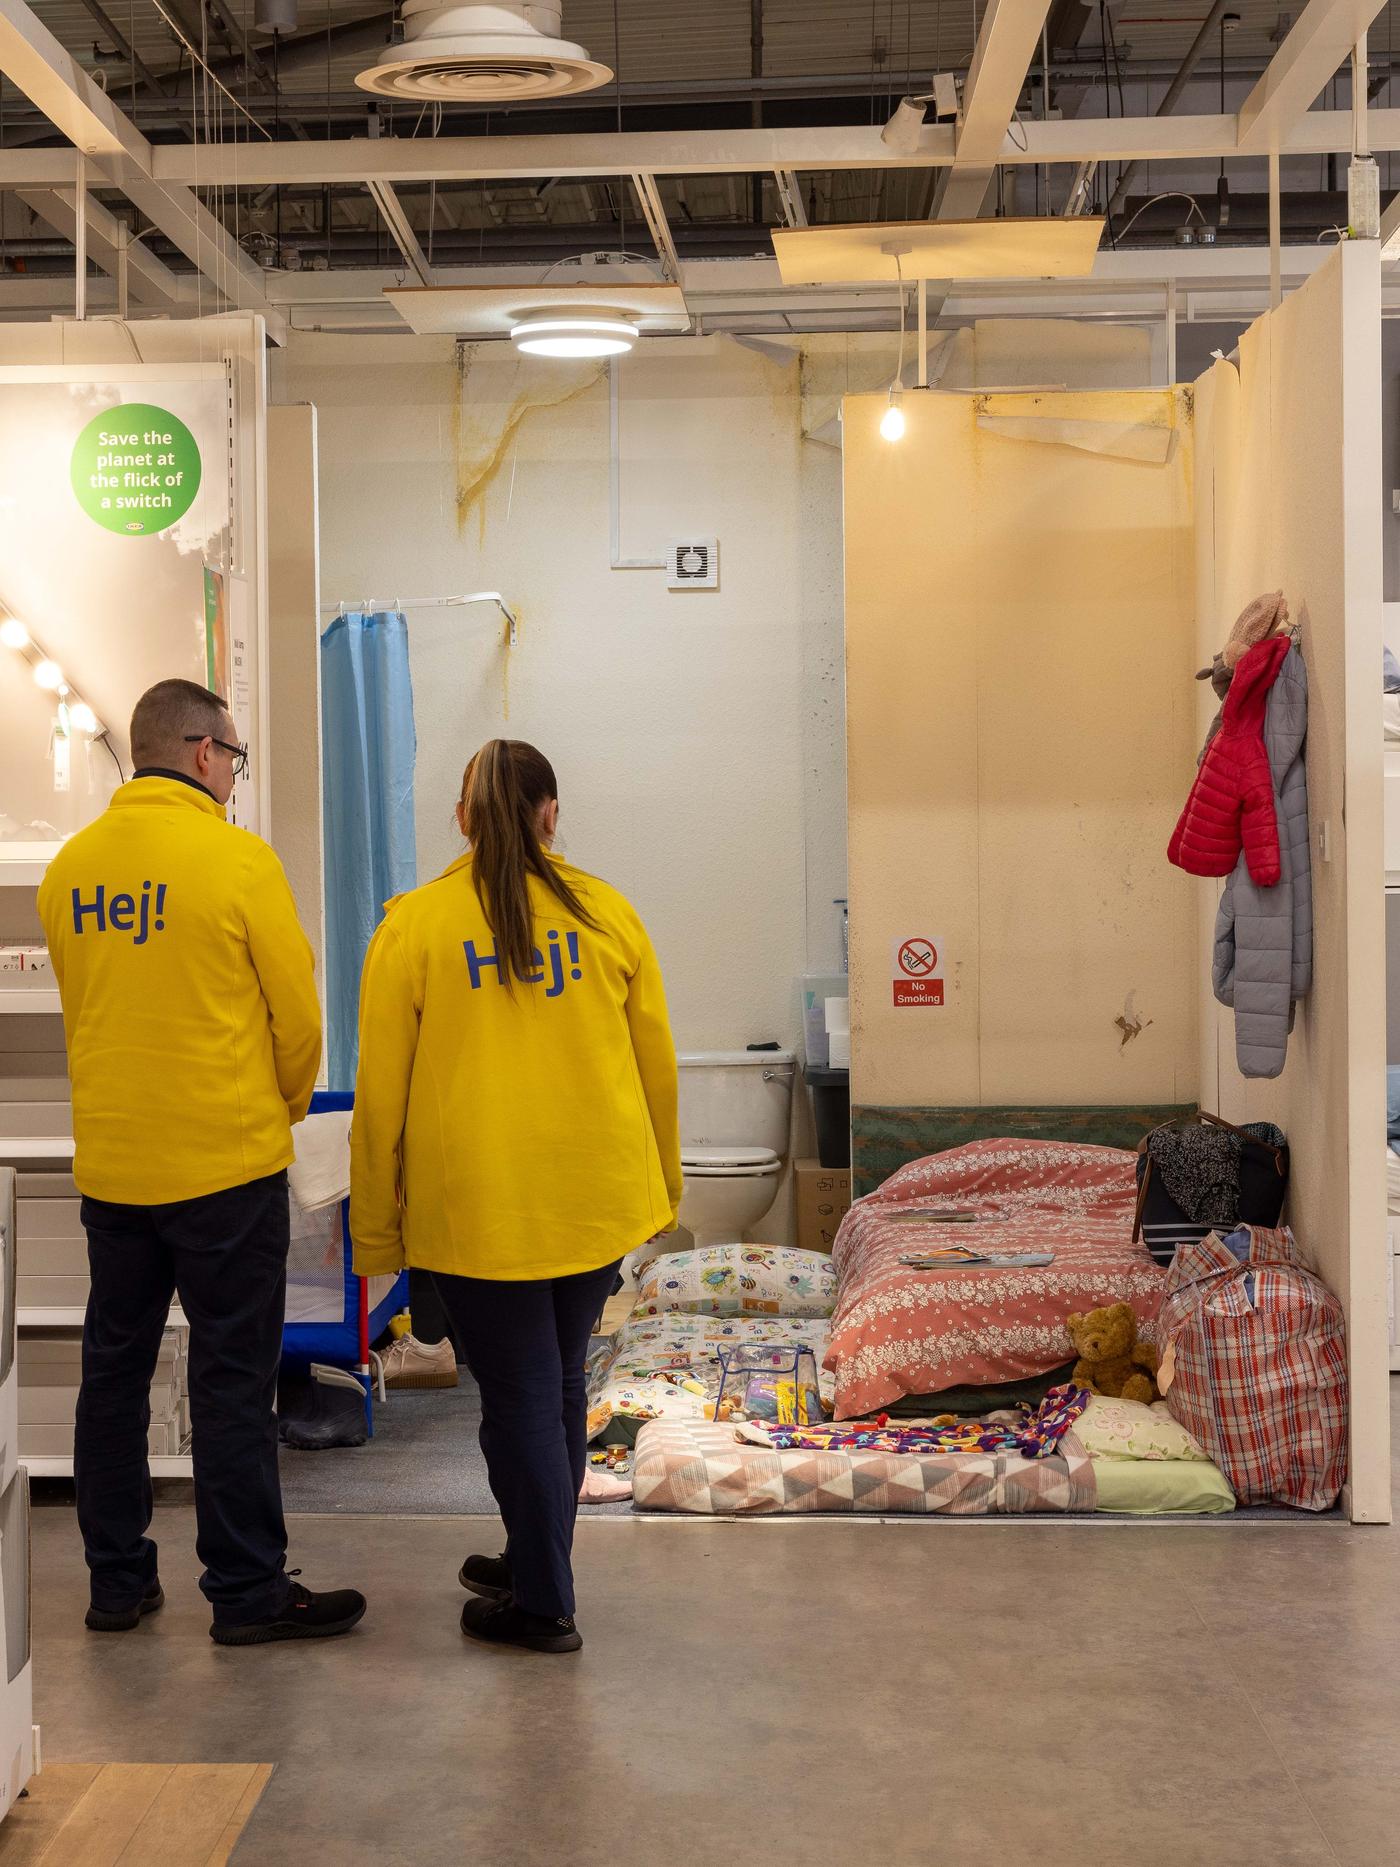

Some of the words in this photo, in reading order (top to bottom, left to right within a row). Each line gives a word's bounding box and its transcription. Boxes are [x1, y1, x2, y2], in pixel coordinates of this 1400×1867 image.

[98, 431, 139, 446] Save
[143, 430, 172, 445] the
[96, 452, 153, 471] planet
[157, 452, 175, 466] at
[90, 473, 119, 488] the
[123, 472, 161, 487] flick
[165, 471, 183, 486] of
[100, 497, 111, 509] a
[116, 493, 172, 508] switch
[72, 880, 167, 945] Hej!
[911, 982, 926, 991] No
[897, 994, 940, 1004] Smoking
